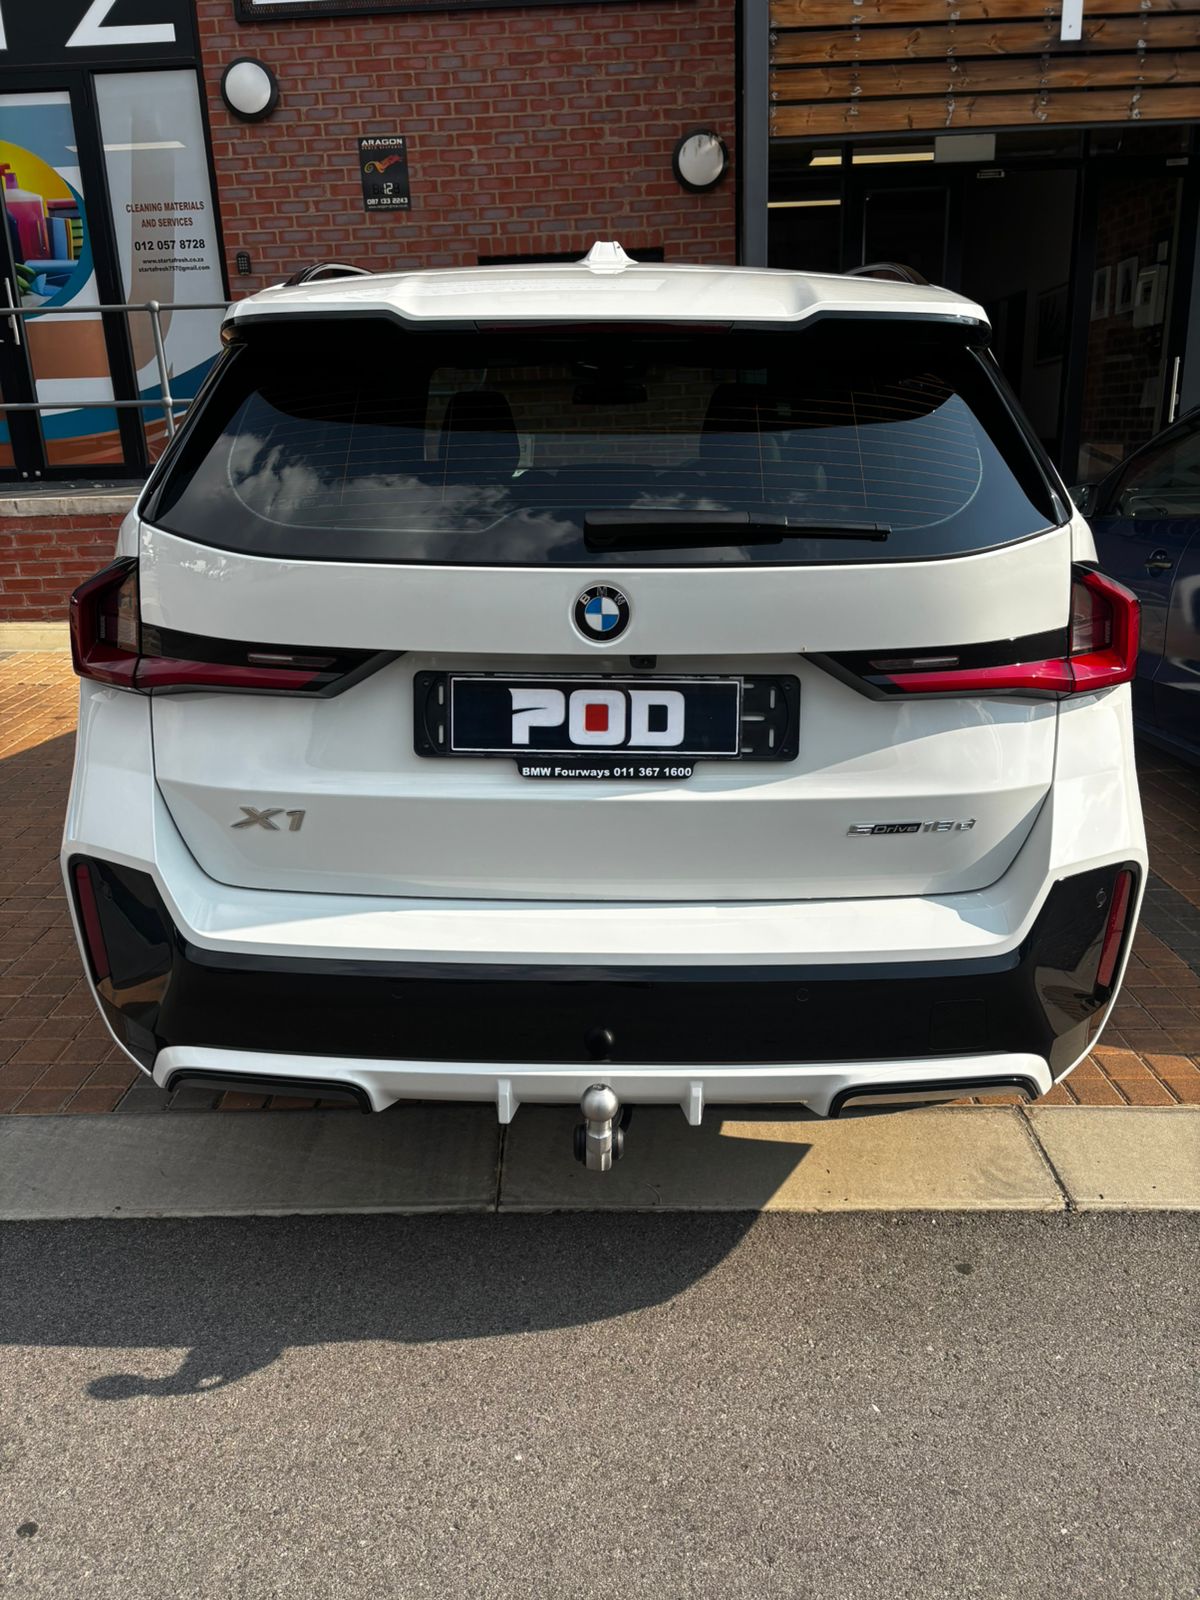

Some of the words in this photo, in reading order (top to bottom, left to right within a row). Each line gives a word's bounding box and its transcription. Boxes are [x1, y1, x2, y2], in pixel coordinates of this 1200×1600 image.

[361, 138, 403, 146] ARAGON
[383, 182, 393, 195] 12
[125, 202, 162, 213] CLEANING
[163, 201, 205, 211] MATERIALS
[141, 219, 157, 228] AND
[158, 217, 193, 227] SERVICES
[134, 241, 154, 251] 012
[157, 240, 176, 250] 057
[179, 239, 206, 249] 8728
[580, 586, 626, 606] BMW
[508, 688, 685, 746] POD
[522, 767, 551, 776] BMW
[554, 767, 610, 779] Fourways
[613, 767, 634, 777] 011
[638, 767, 659, 777] 367
[664, 767, 692, 777] 1600
[230, 806, 306, 832] X1
